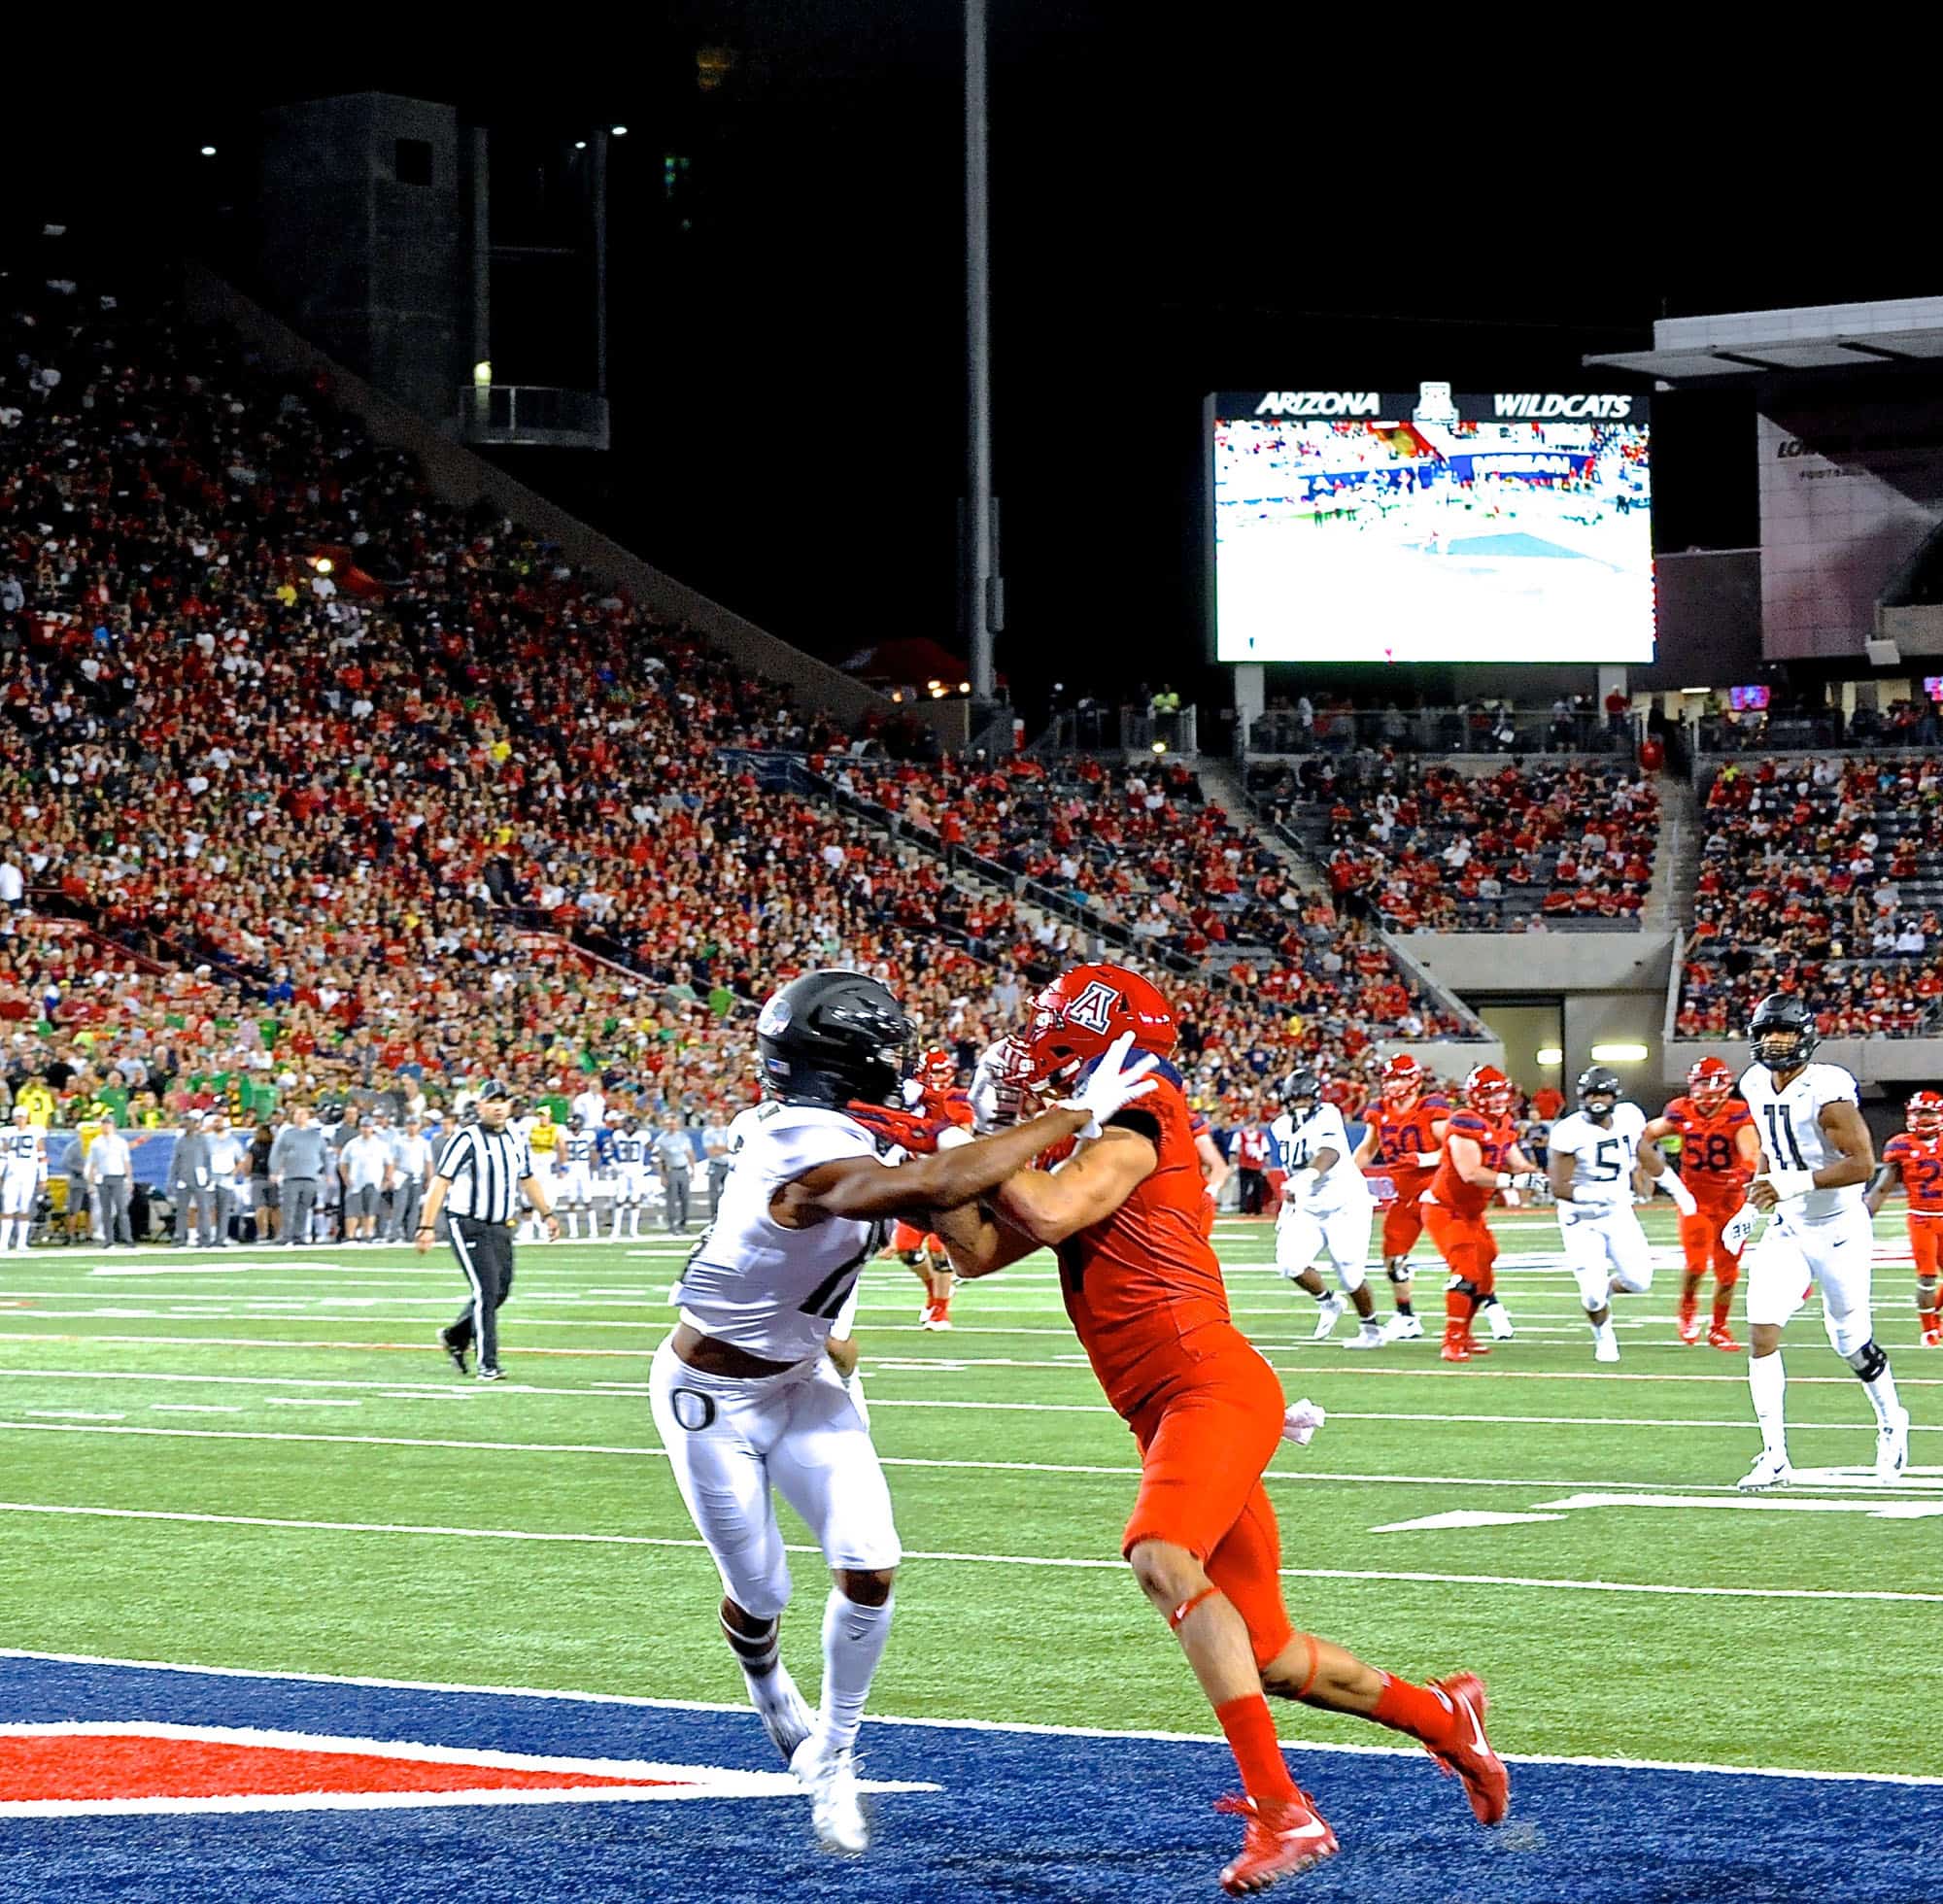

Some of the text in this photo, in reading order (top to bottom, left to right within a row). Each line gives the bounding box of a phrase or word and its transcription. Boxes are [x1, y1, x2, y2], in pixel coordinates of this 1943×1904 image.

[1255, 391, 1632, 418] ARIZONA WILDCATS
[1062, 981, 1119, 1036] A
[1380, 1124, 1422, 1163] 50
[1685, 1126, 1731, 1172] 58
[1763, 1104, 1809, 1172] 11
[1912, 1159, 1942, 1199] 2
